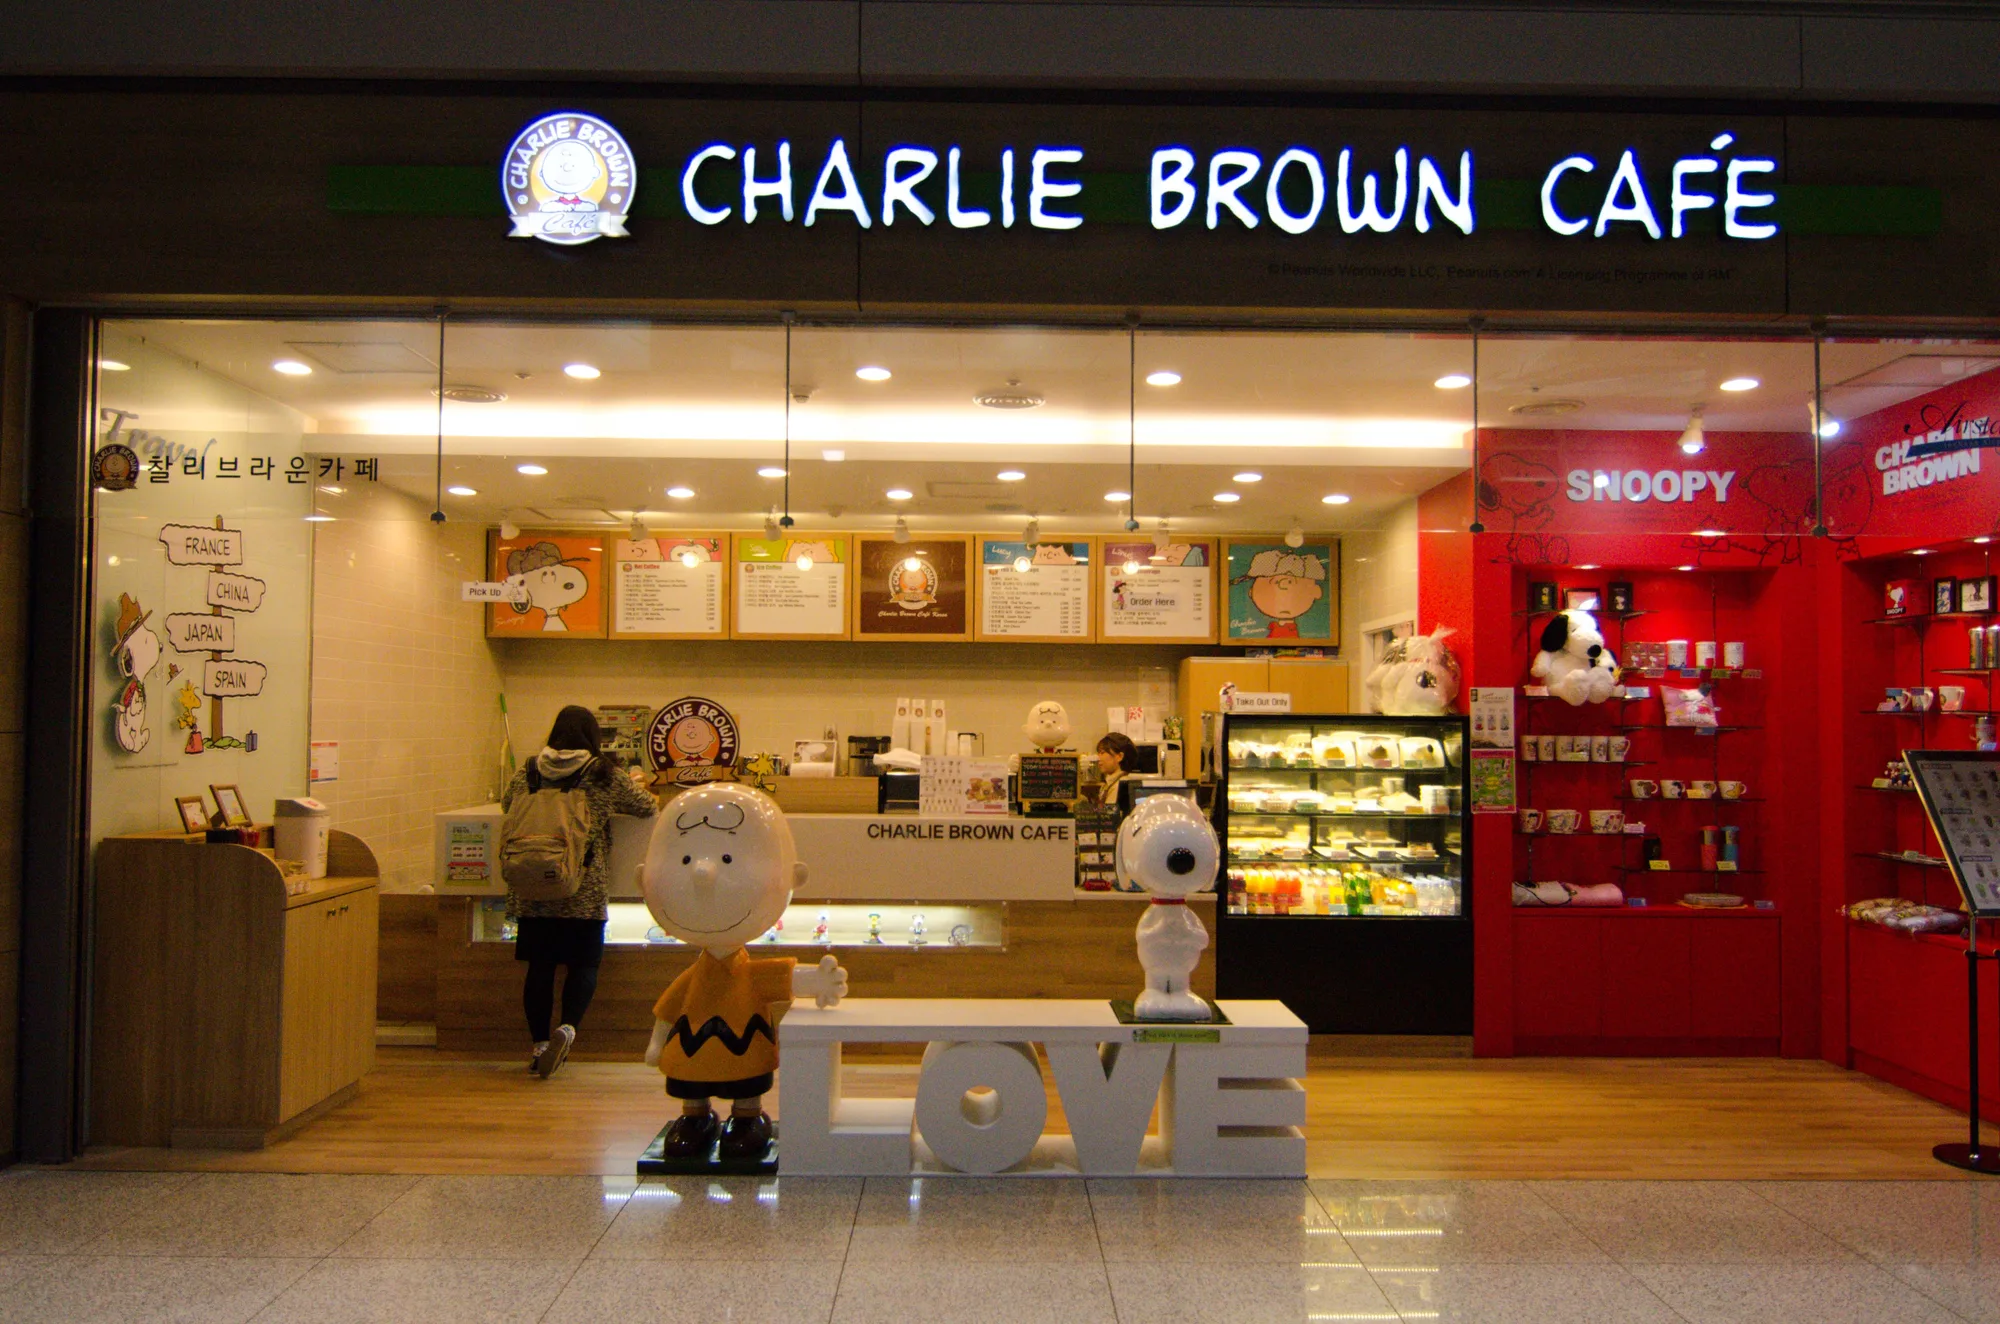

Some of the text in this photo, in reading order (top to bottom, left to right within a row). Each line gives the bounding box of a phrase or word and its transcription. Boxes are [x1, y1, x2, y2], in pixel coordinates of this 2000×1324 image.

[510, 120, 629, 189] CHARLIE BROWN
[681, 132, 1777, 240] CHARLIE BROWN CAFÉ
[542, 213, 597, 236] Café
[147, 455, 379, 484] 찰리브라운카페
[1882, 448, 1980, 496] BROWN
[1566, 469, 1736, 503] SNOOPY
[185, 537, 231, 556] FRANCE
[216, 582, 250, 604] CHINA
[469, 588, 502, 597] Pick Up
[1130, 597, 1175, 606] Order Here
[1886, 607, 1903, 615] SNOOPY
[1230, 617, 1257, 628] Charlie
[184, 623, 223, 643] JAPAN
[214, 670, 247, 689] SPAIN
[1271, 698, 1288, 706] Only
[653, 703, 734, 752] CHARLIE BROWN
[676, 767, 712, 783] Café
[867, 823, 1069, 840] CHARLIE BROWN CAFE
[777, 1040, 1307, 1178] LOVE
